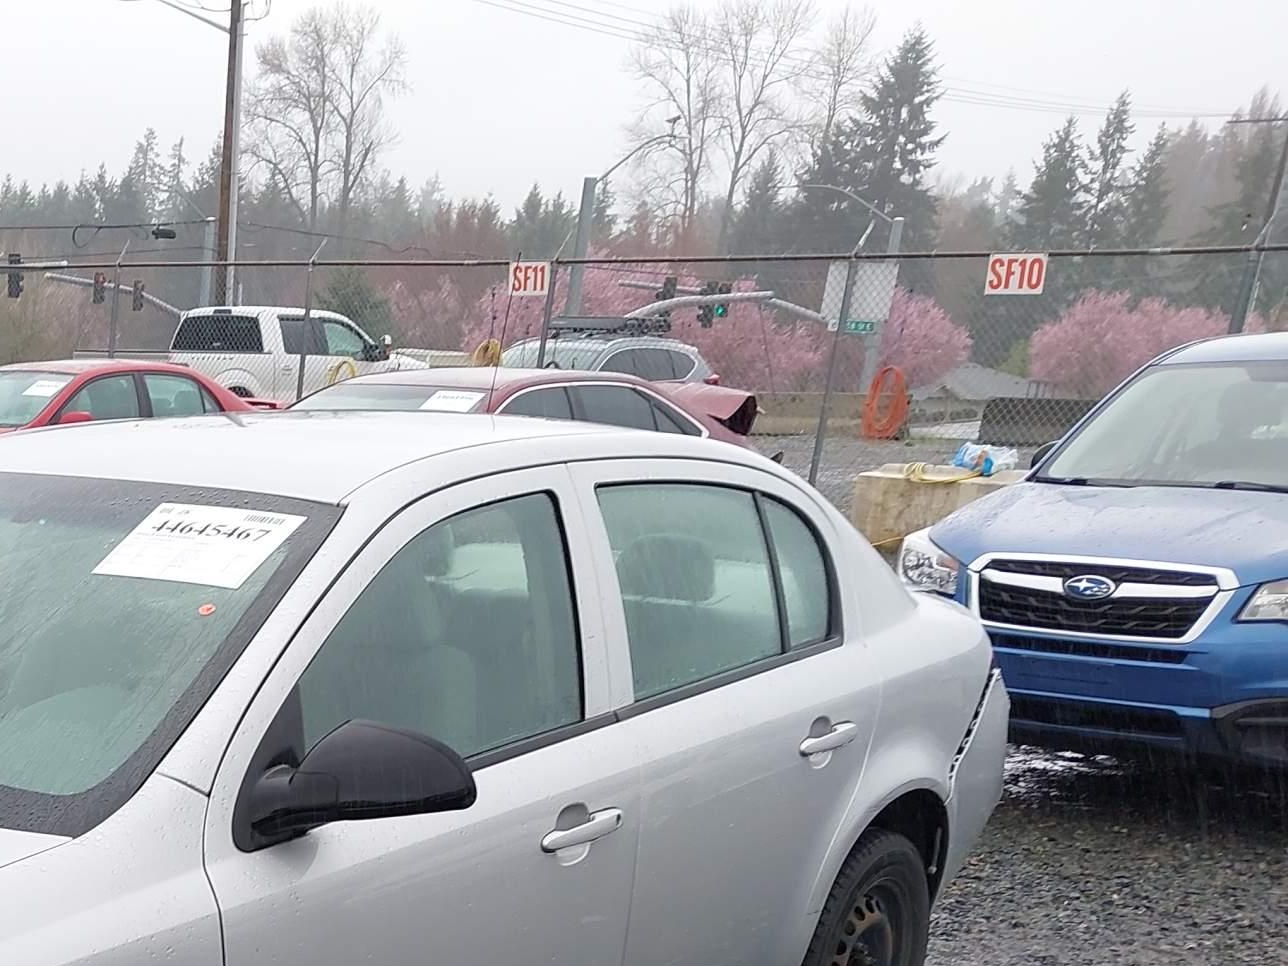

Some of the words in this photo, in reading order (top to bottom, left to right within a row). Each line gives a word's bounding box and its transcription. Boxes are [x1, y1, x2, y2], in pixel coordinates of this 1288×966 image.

[513, 265, 545, 291] SF11
[988, 258, 1044, 290] SF10
[152, 520, 271, 541] 44645467
